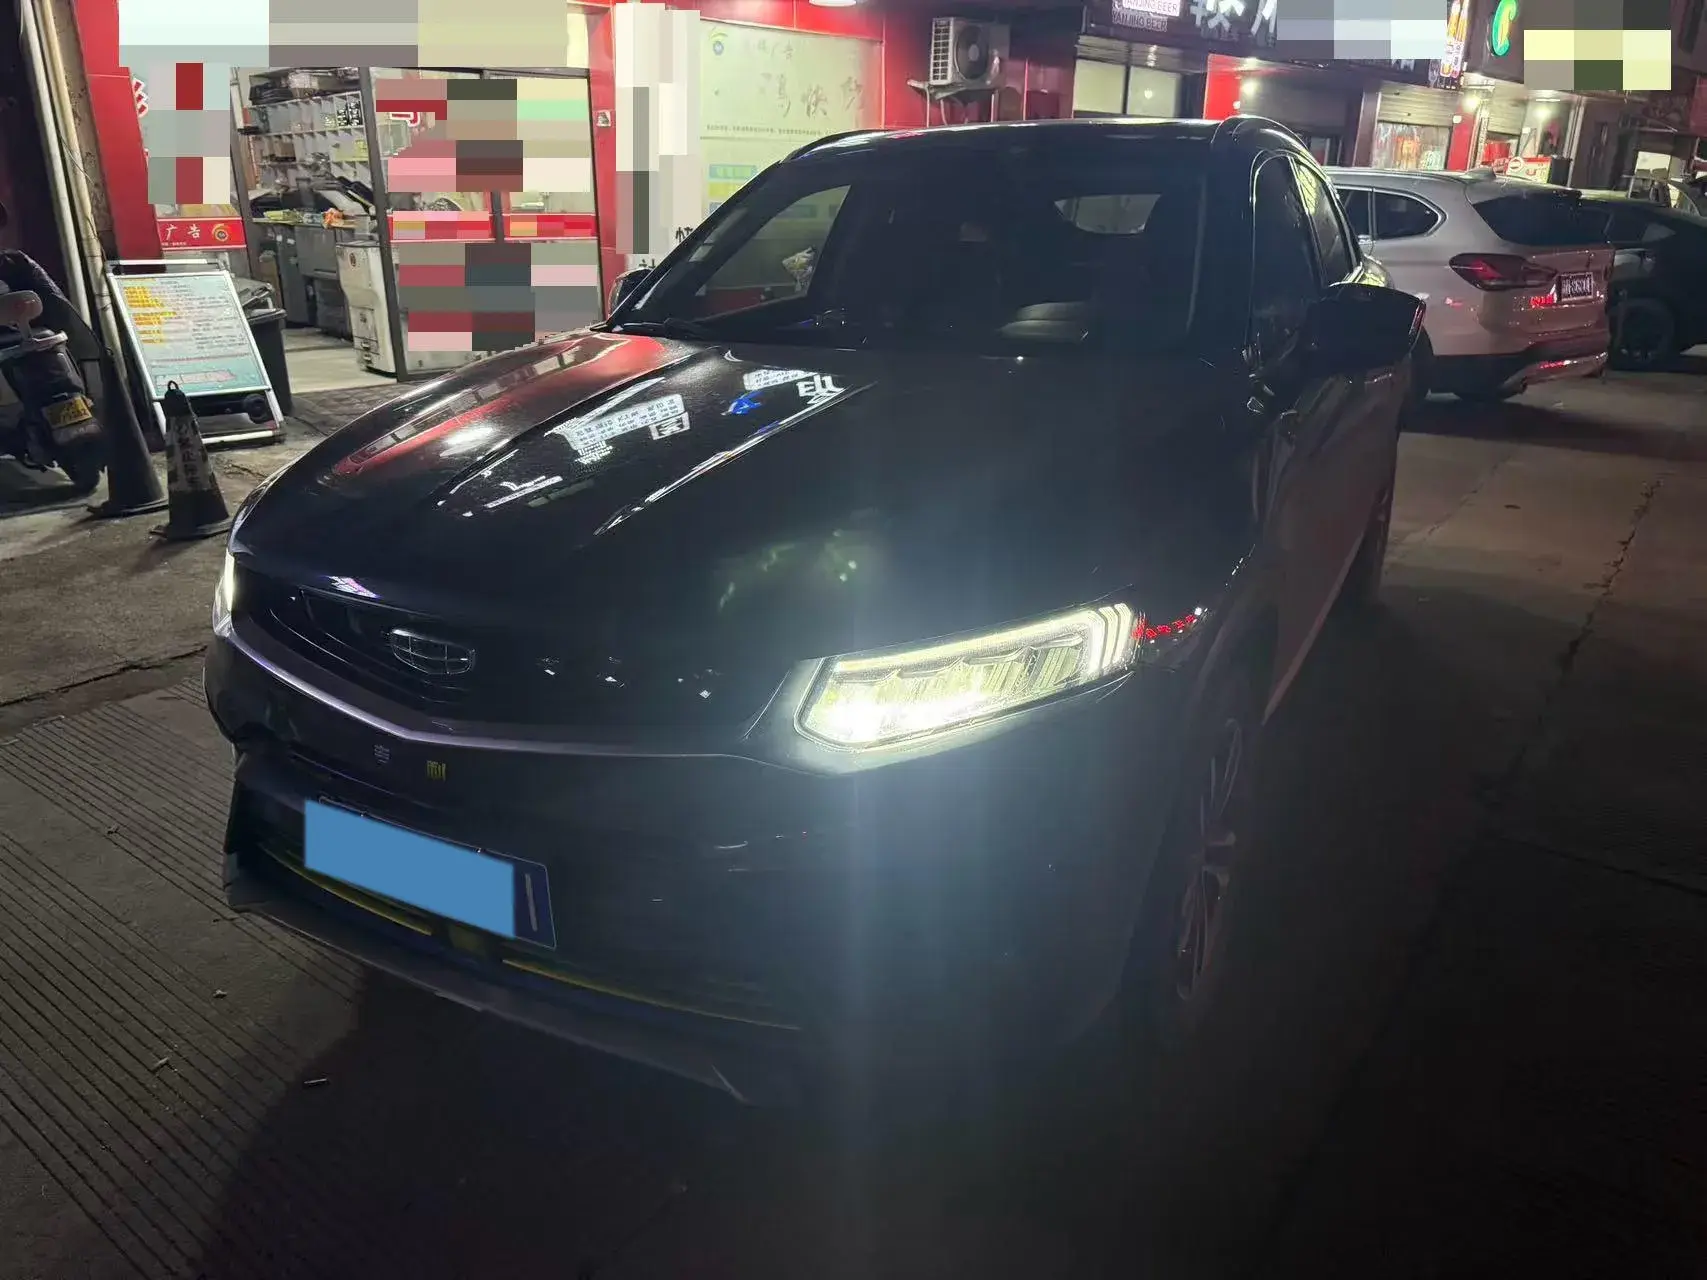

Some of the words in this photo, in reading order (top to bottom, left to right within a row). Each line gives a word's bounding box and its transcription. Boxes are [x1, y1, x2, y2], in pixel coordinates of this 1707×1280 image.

[1157, 2, 1178, 13] BEER
[1146, 18, 1168, 31] BEER
[166, 224, 201, 240] 广告
